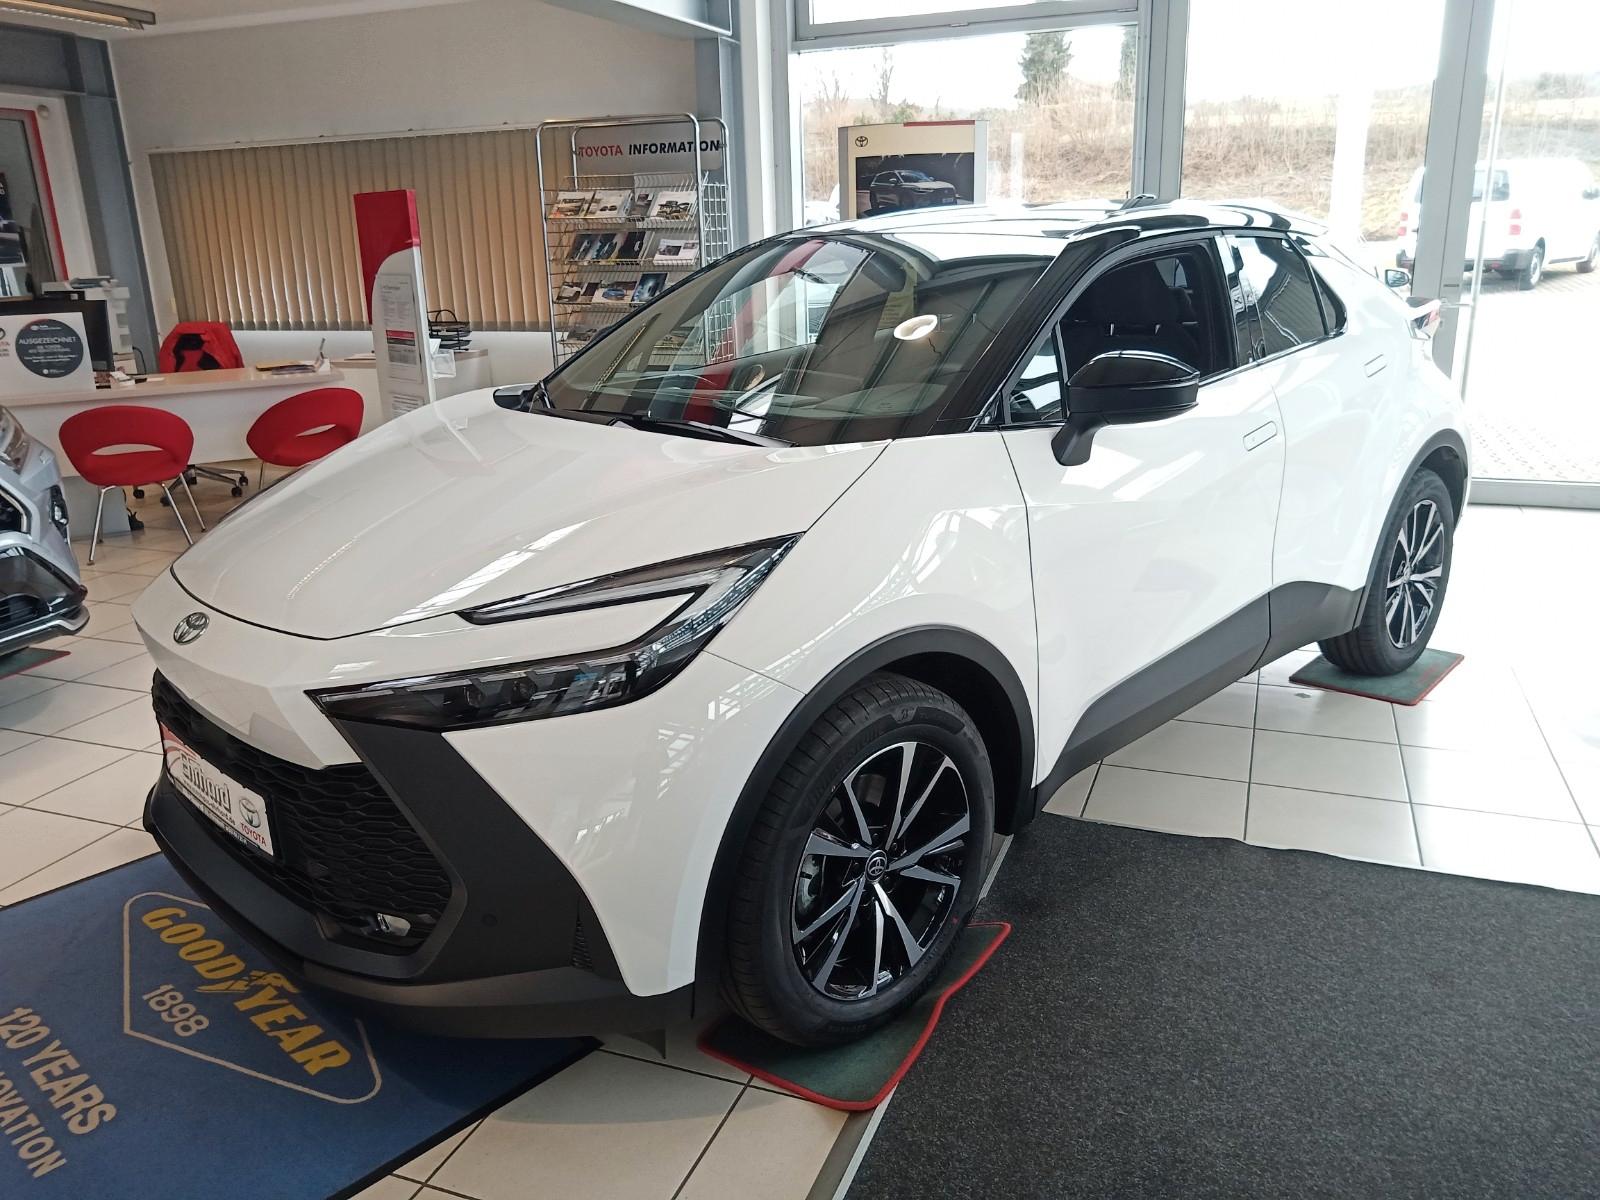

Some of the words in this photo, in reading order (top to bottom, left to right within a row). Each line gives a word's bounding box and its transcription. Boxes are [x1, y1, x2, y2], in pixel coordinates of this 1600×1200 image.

[578, 144, 623, 158] TOYOTA
[629, 139, 720, 156] INFORMATON
[240, 822, 267, 847] TOYOTA
[141, 906, 352, 1077] GOODYEAR
[142, 984, 210, 1038] 1898
[0, 1007, 50, 1050] 120
[22, 1039, 118, 1135] YEARS
[0, 1071, 68, 1179] VATION
